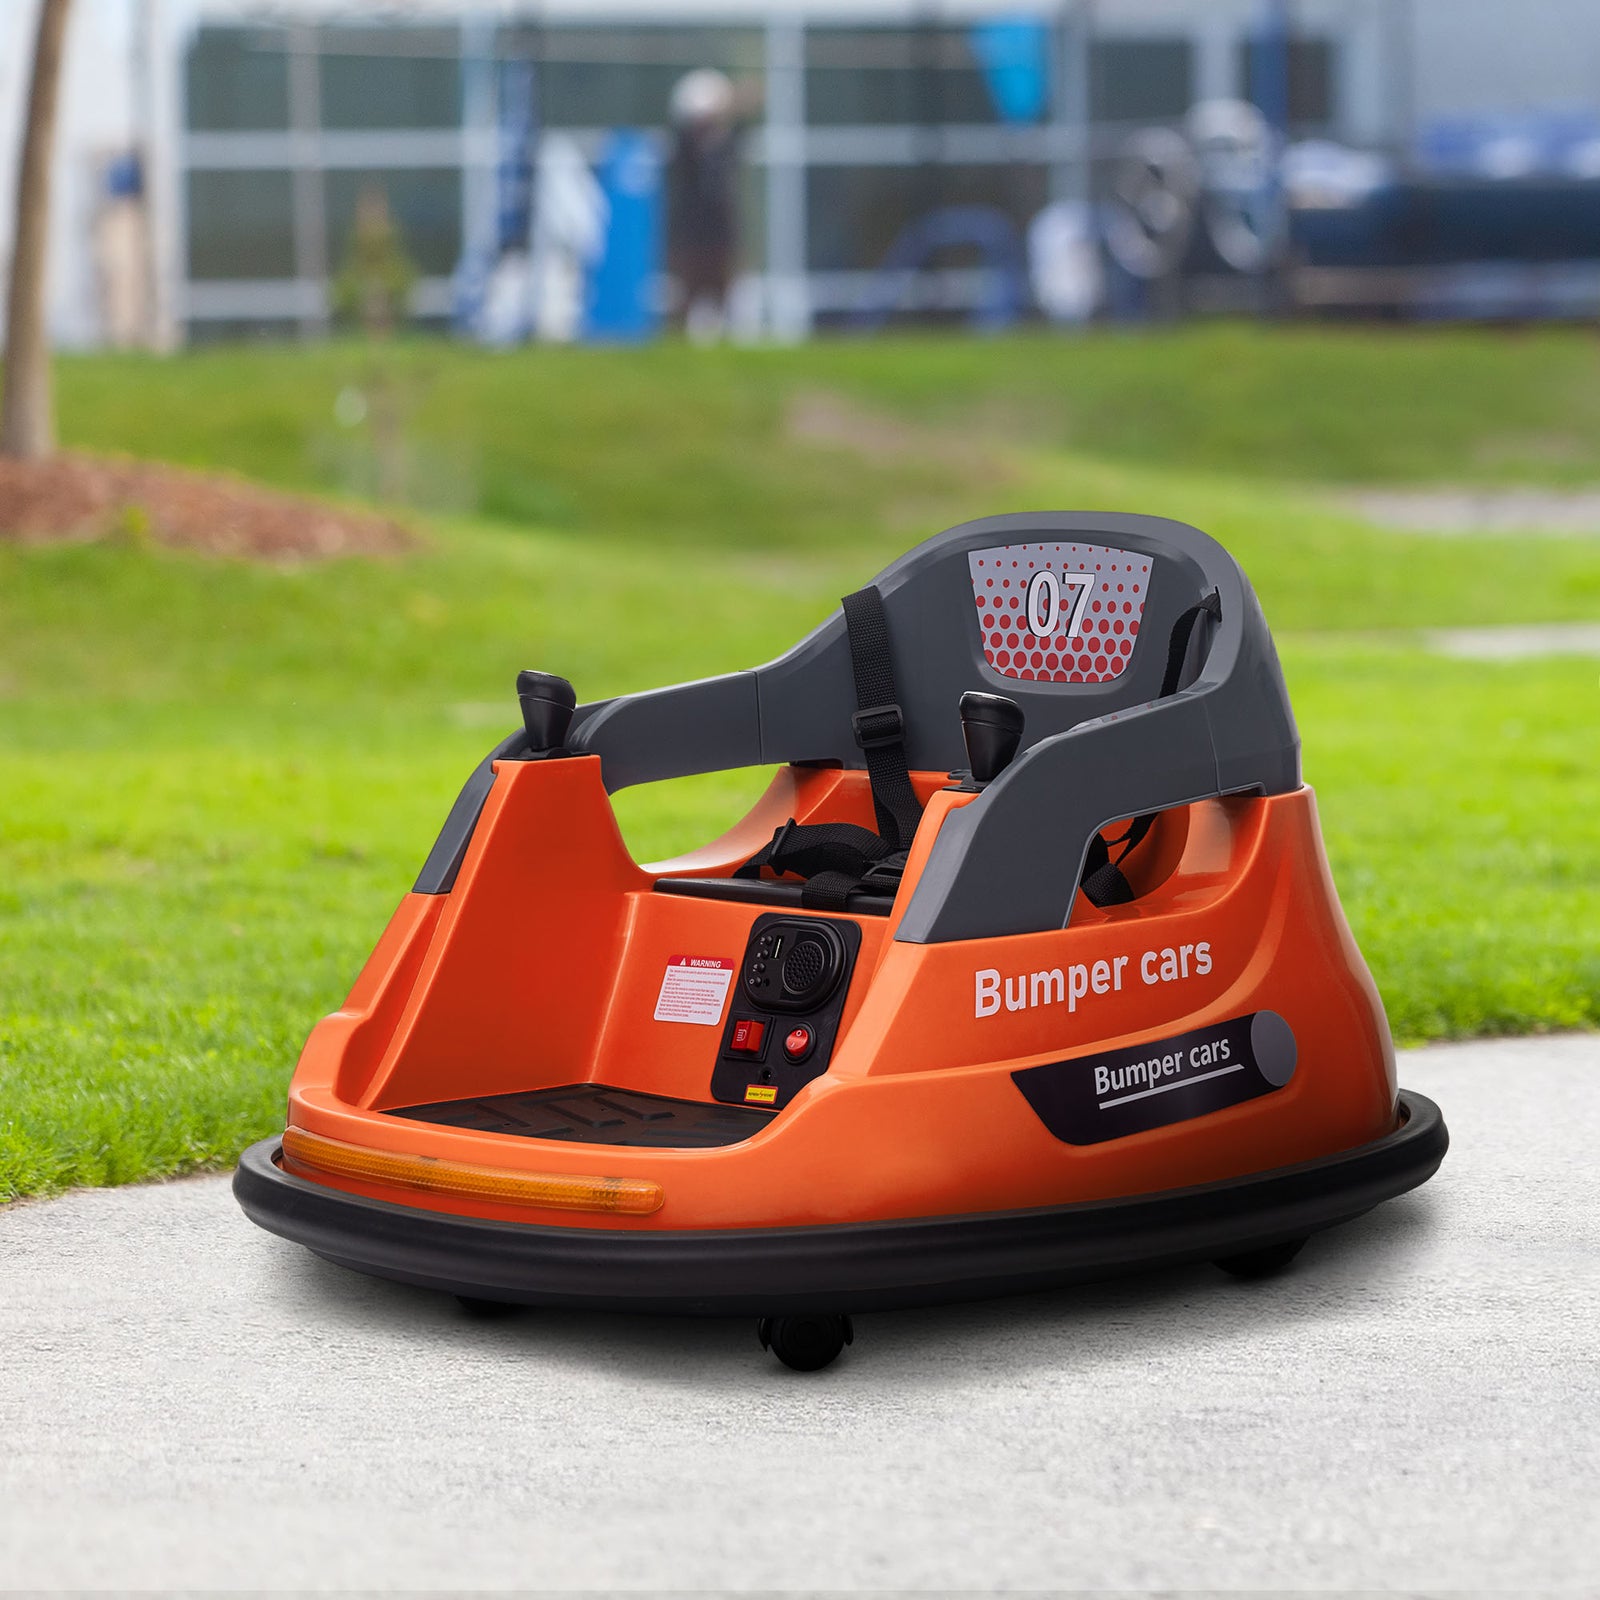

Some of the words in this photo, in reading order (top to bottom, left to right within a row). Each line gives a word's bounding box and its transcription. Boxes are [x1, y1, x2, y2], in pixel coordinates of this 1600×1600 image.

[1026, 570, 1096, 638] 07
[690, 958, 722, 969] WARNING
[975, 956, 1128, 1018] Bumper
[1140, 942, 1213, 985] cars
[1094, 1052, 1183, 1095] Bumper
[1189, 1037, 1231, 1069] cars
